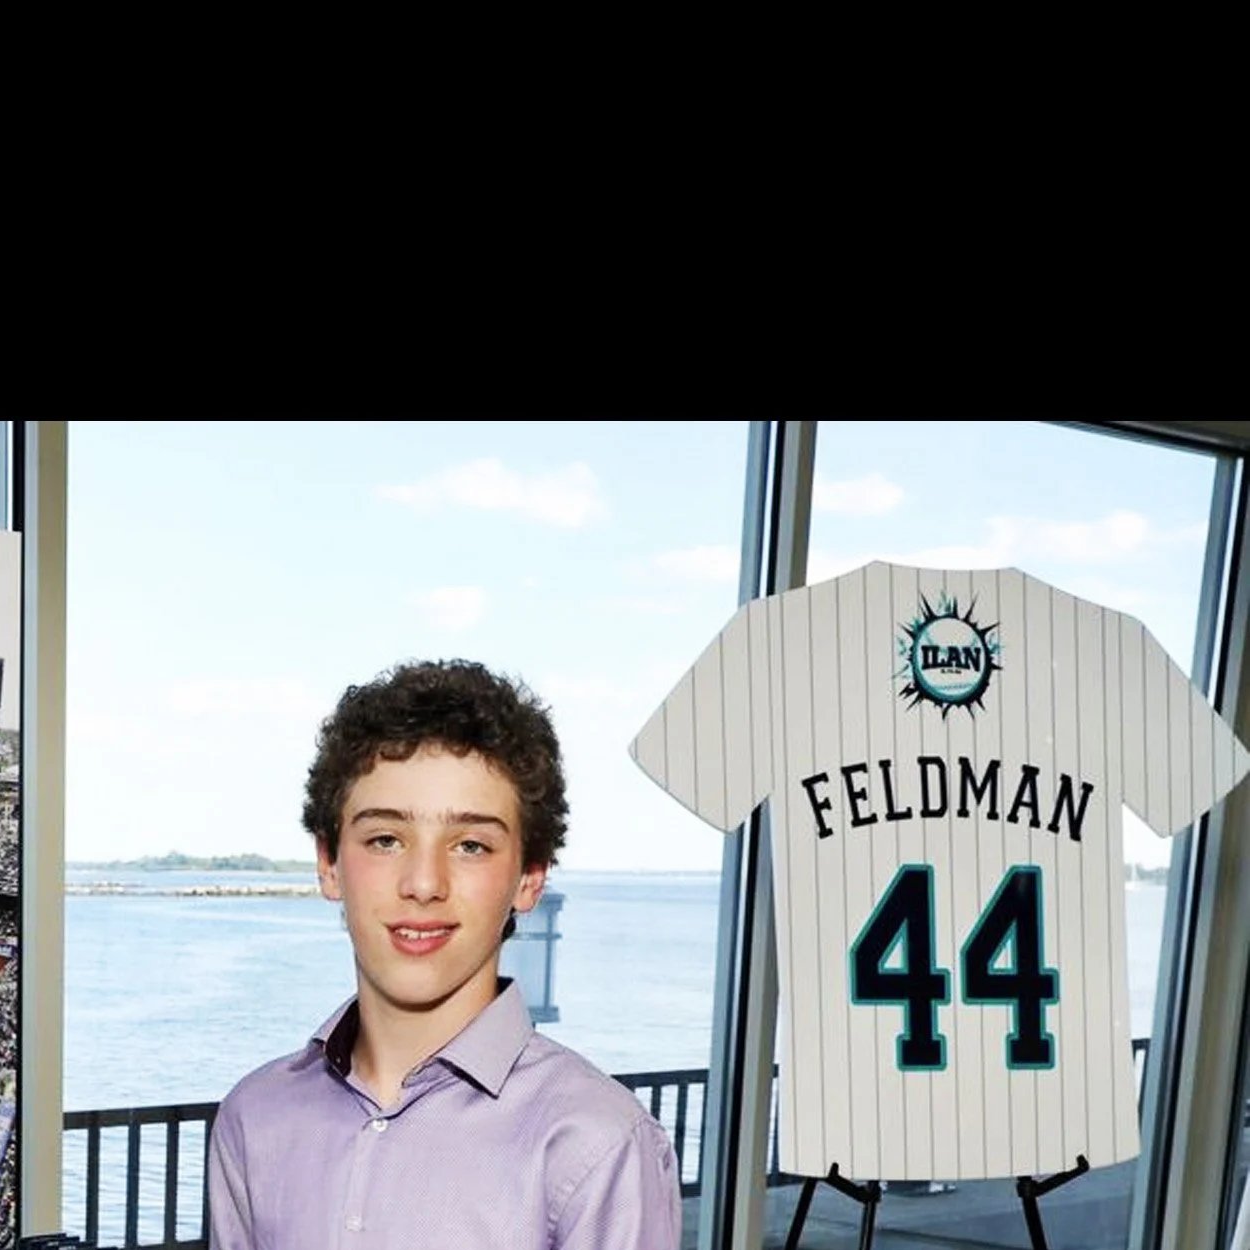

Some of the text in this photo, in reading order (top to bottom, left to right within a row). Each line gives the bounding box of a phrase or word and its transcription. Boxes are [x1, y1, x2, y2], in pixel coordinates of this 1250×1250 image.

[920, 645, 981, 672] ILAN
[801, 755, 1094, 843] FELDMAN
[848, 862, 1061, 1072] 44
